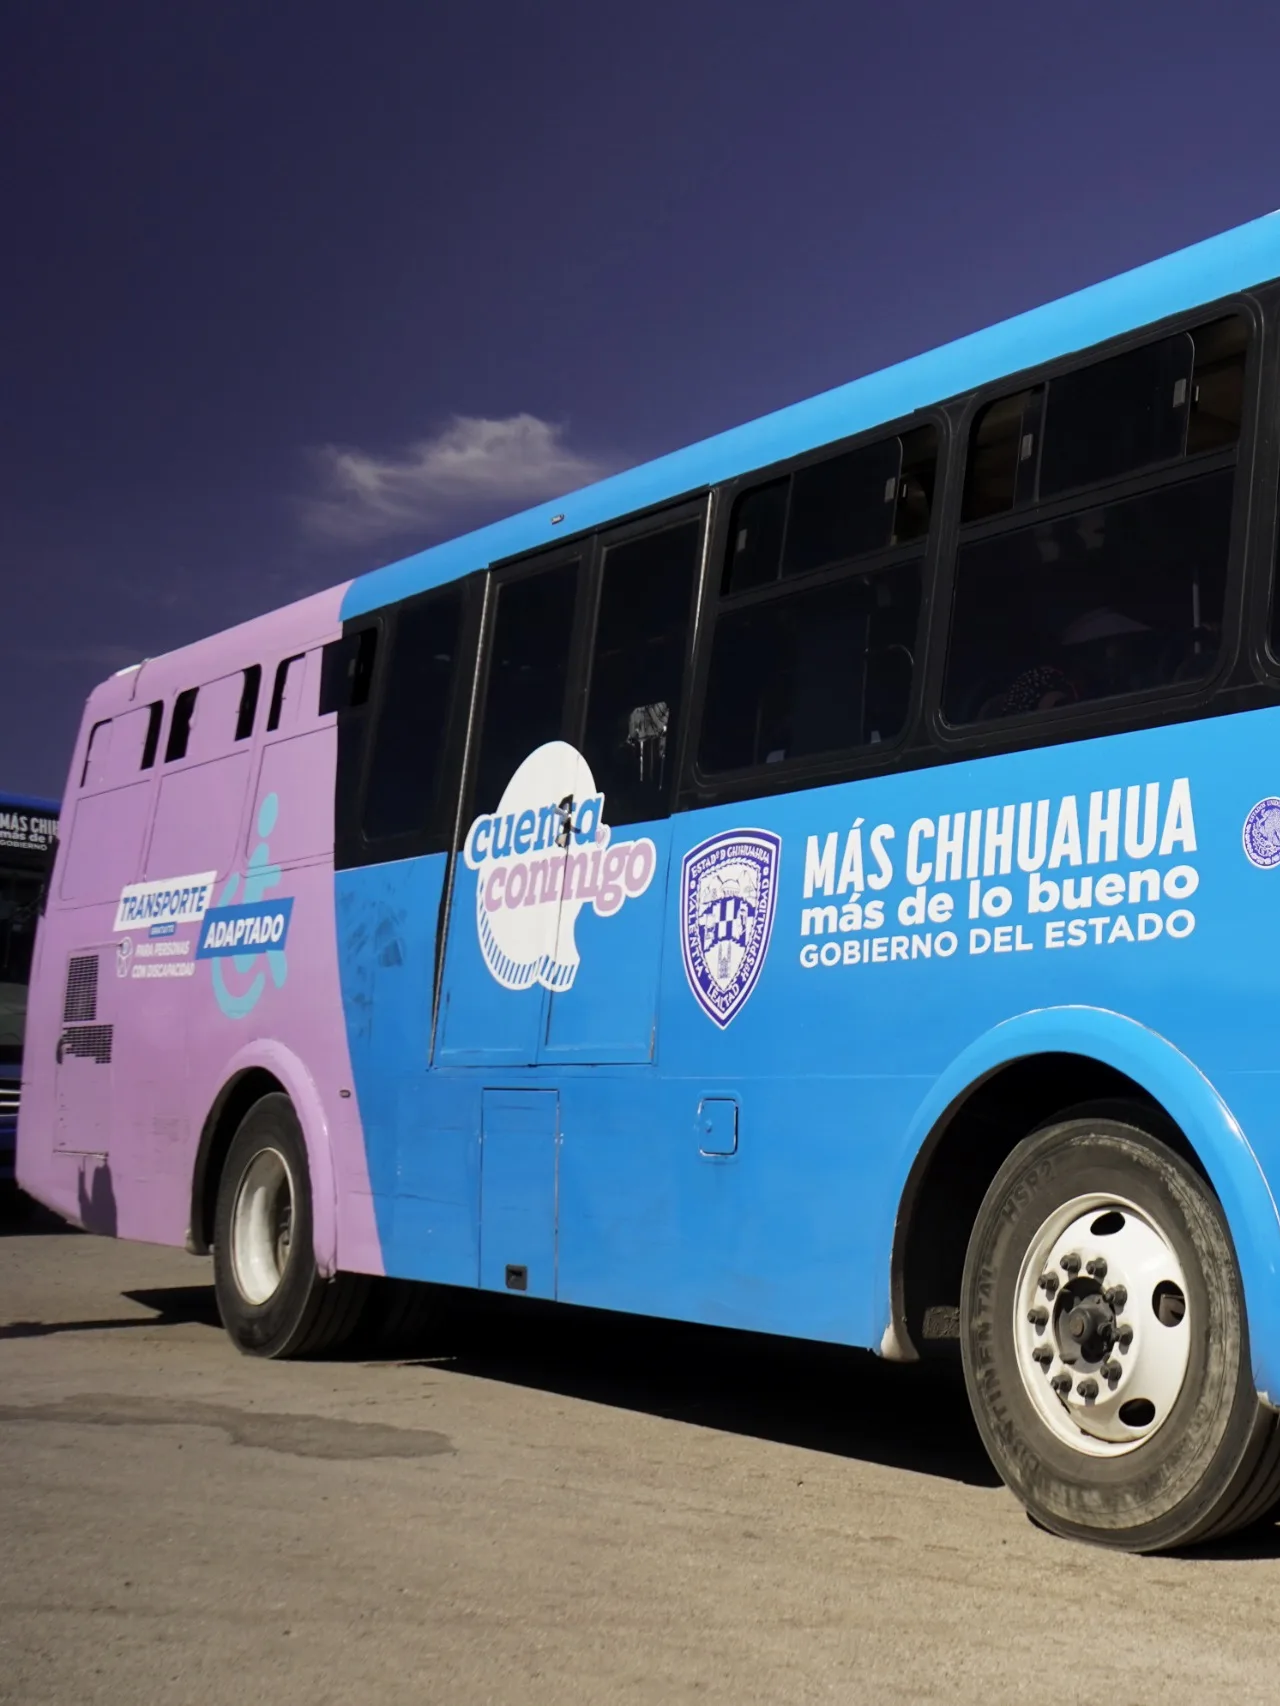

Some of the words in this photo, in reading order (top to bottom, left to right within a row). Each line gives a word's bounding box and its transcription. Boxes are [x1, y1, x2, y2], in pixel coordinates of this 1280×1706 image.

[0, 812, 28, 832] MÁS
[0, 830, 26, 840] más
[29, 833, 46, 843] de
[0, 840, 47, 851] GOBIERNO
[803, 817, 895, 899] MÁS
[906, 777, 1198, 886] CHIHUAHUA
[727, 845, 770, 864] CHIHUAHUA
[485, 841, 654, 913] conmigo
[121, 886, 207, 921] TRANSPORTE
[801, 892, 885, 936] más
[897, 887, 955, 926] de
[968, 880, 1013, 920] lo
[1028, 865, 1200, 914] bueno
[204, 914, 284, 949] ADAPTADO
[799, 931, 959, 968] GOBIERNO
[969, 924, 1034, 955] DEL
[1045, 909, 1196, 950] ESTADO
[155, 940, 190, 956] PERSONAS
[147, 962, 195, 978] DISCAPACIDAD
[706, 982, 741, 1011] LEALTAD
